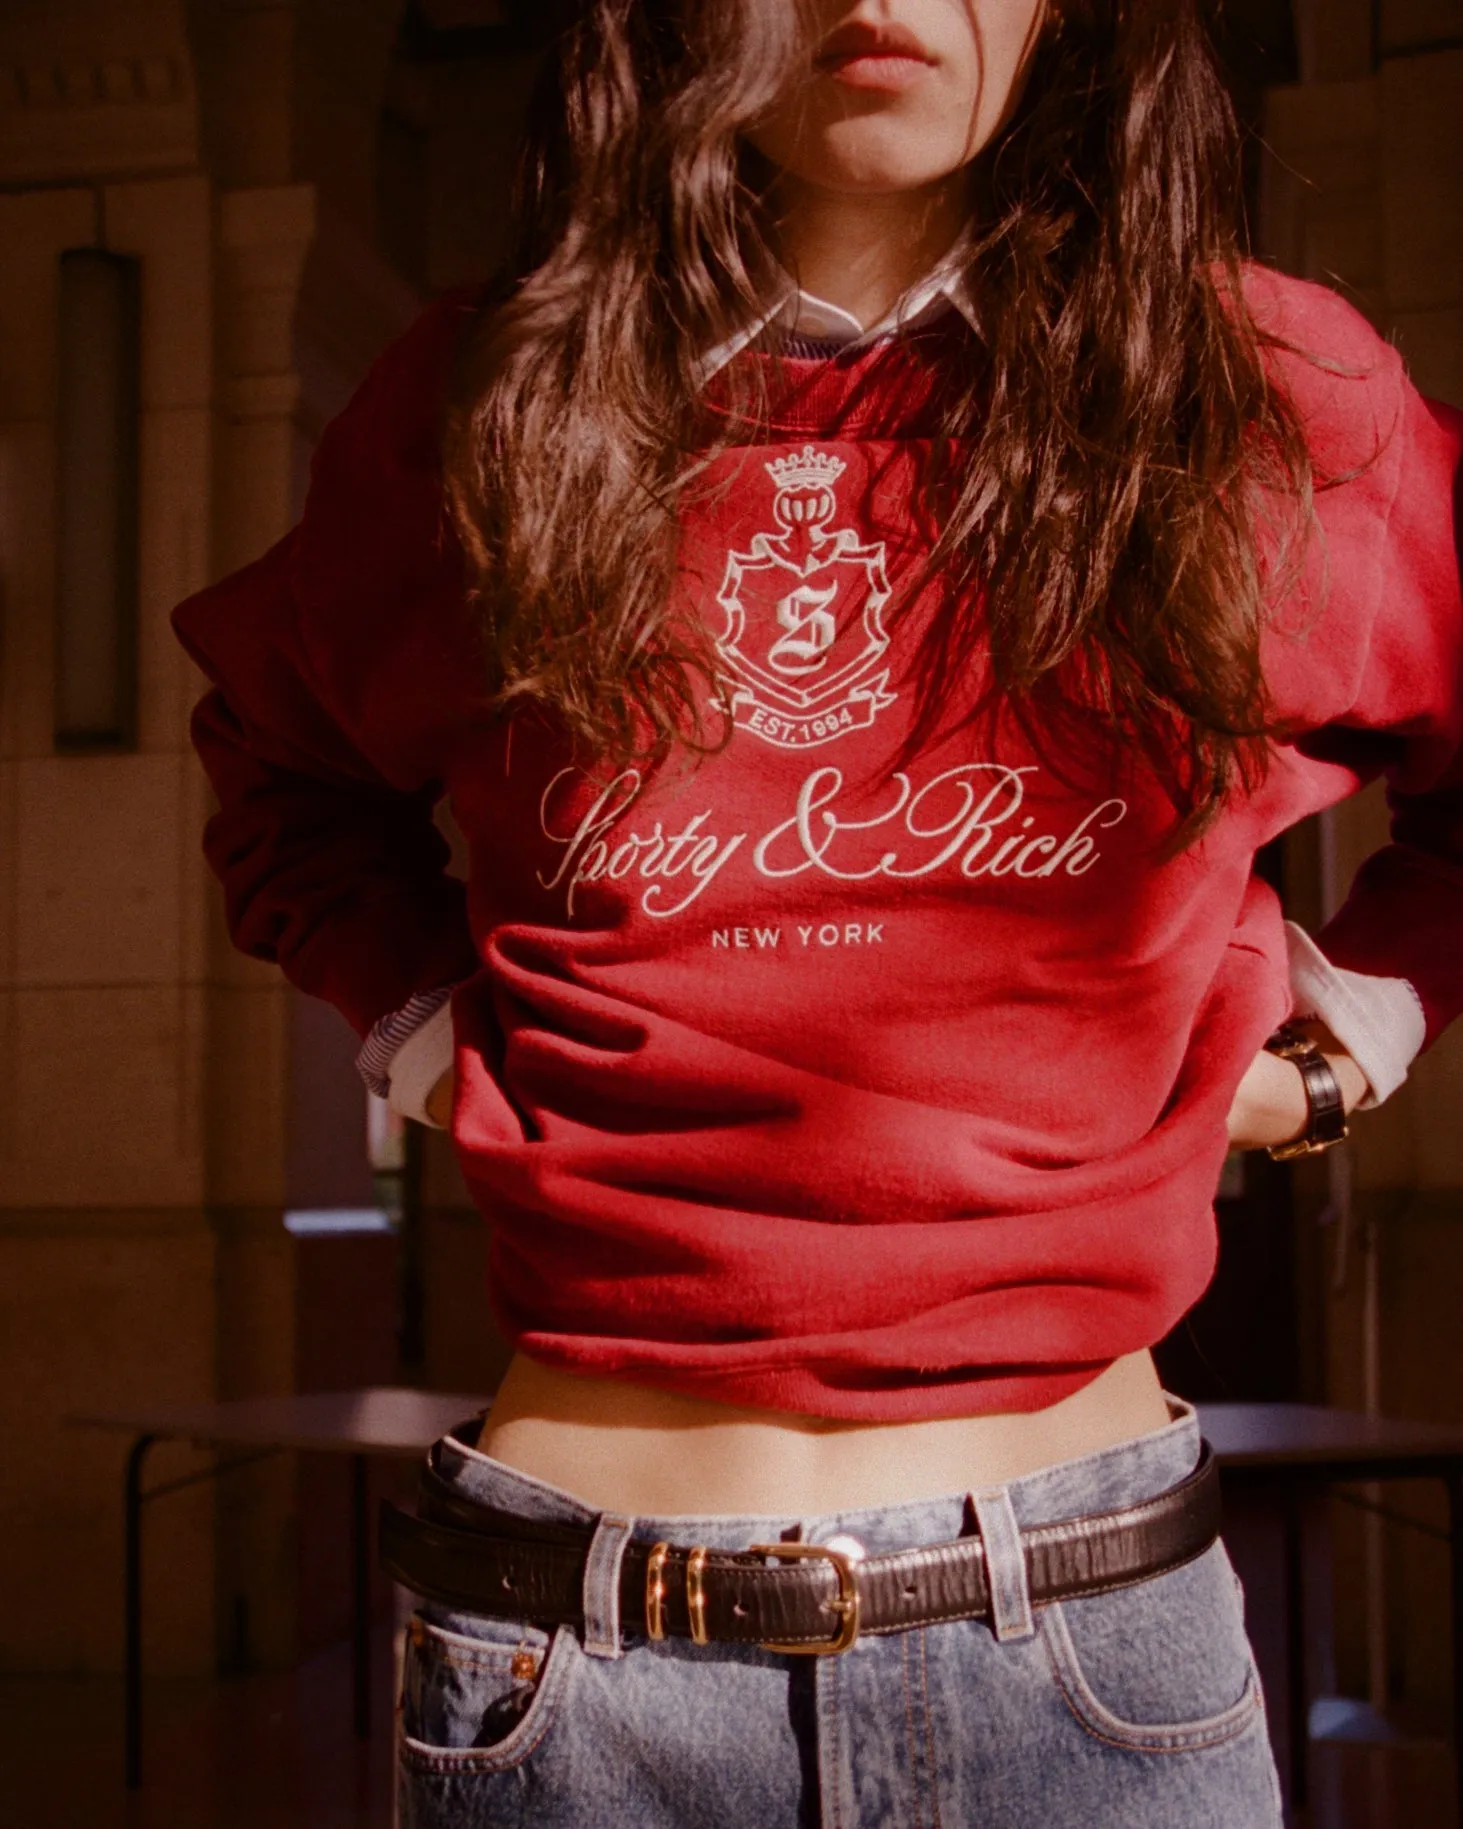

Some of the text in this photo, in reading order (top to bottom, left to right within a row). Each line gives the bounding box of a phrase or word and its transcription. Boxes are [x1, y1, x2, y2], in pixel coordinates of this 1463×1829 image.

[768, 578, 838, 675] S
[536, 762, 1127, 921] Sporty & Rich
[711, 923, 884, 949] NEW YORK
